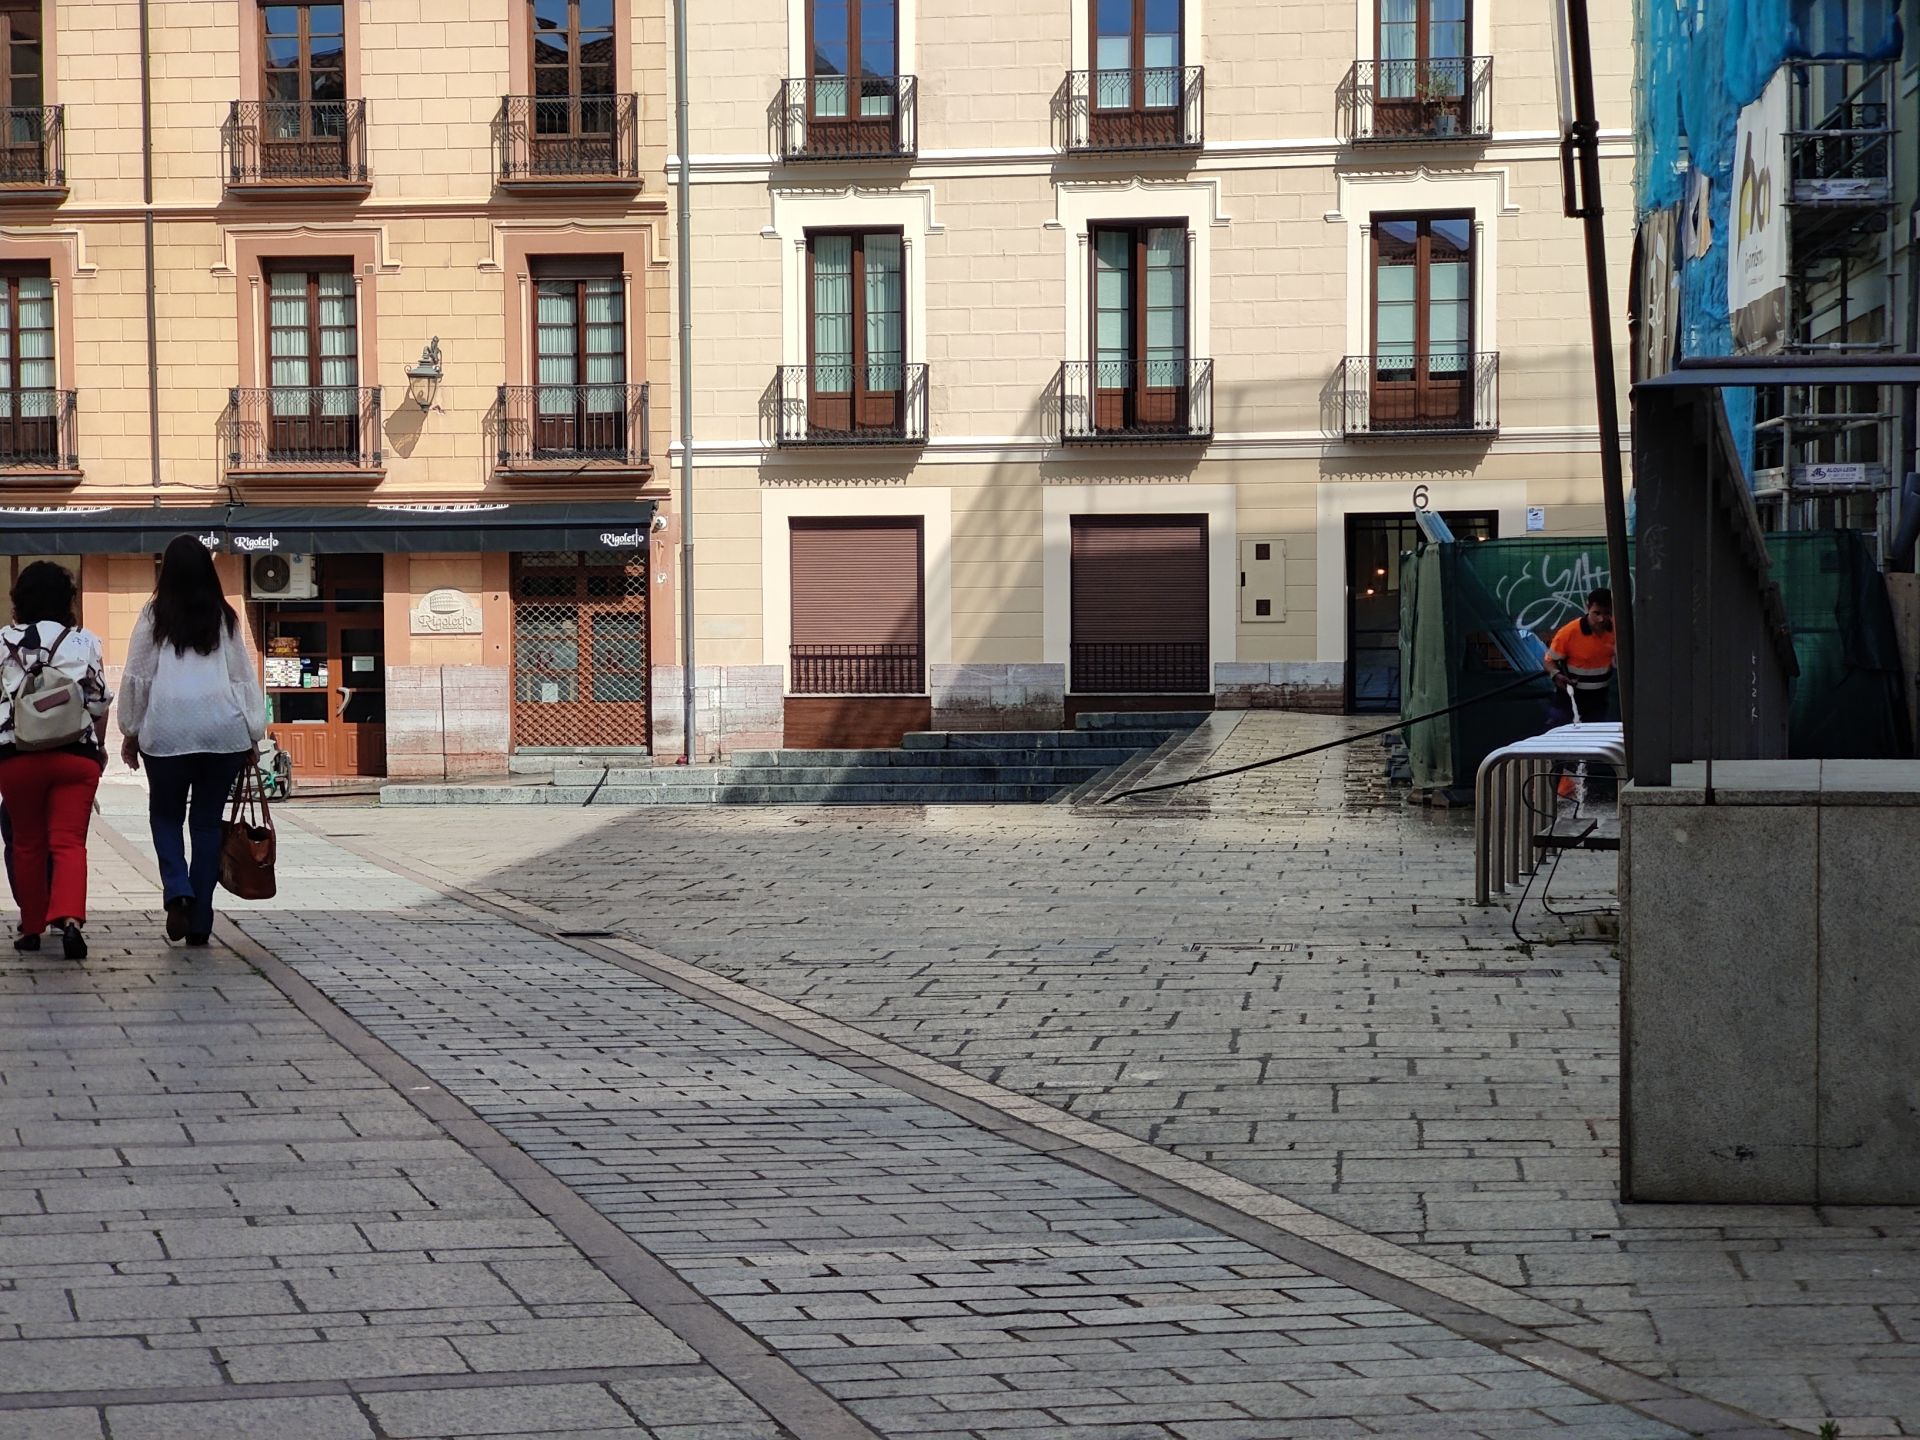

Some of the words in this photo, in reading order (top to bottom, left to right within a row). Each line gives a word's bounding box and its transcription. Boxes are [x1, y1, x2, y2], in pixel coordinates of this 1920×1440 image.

[1412, 484, 1429, 510] 6
[234, 532, 279, 552] Rigoletto
[600, 528, 644, 548] Rigoletto
[417, 608, 473, 633] Rigoletto
